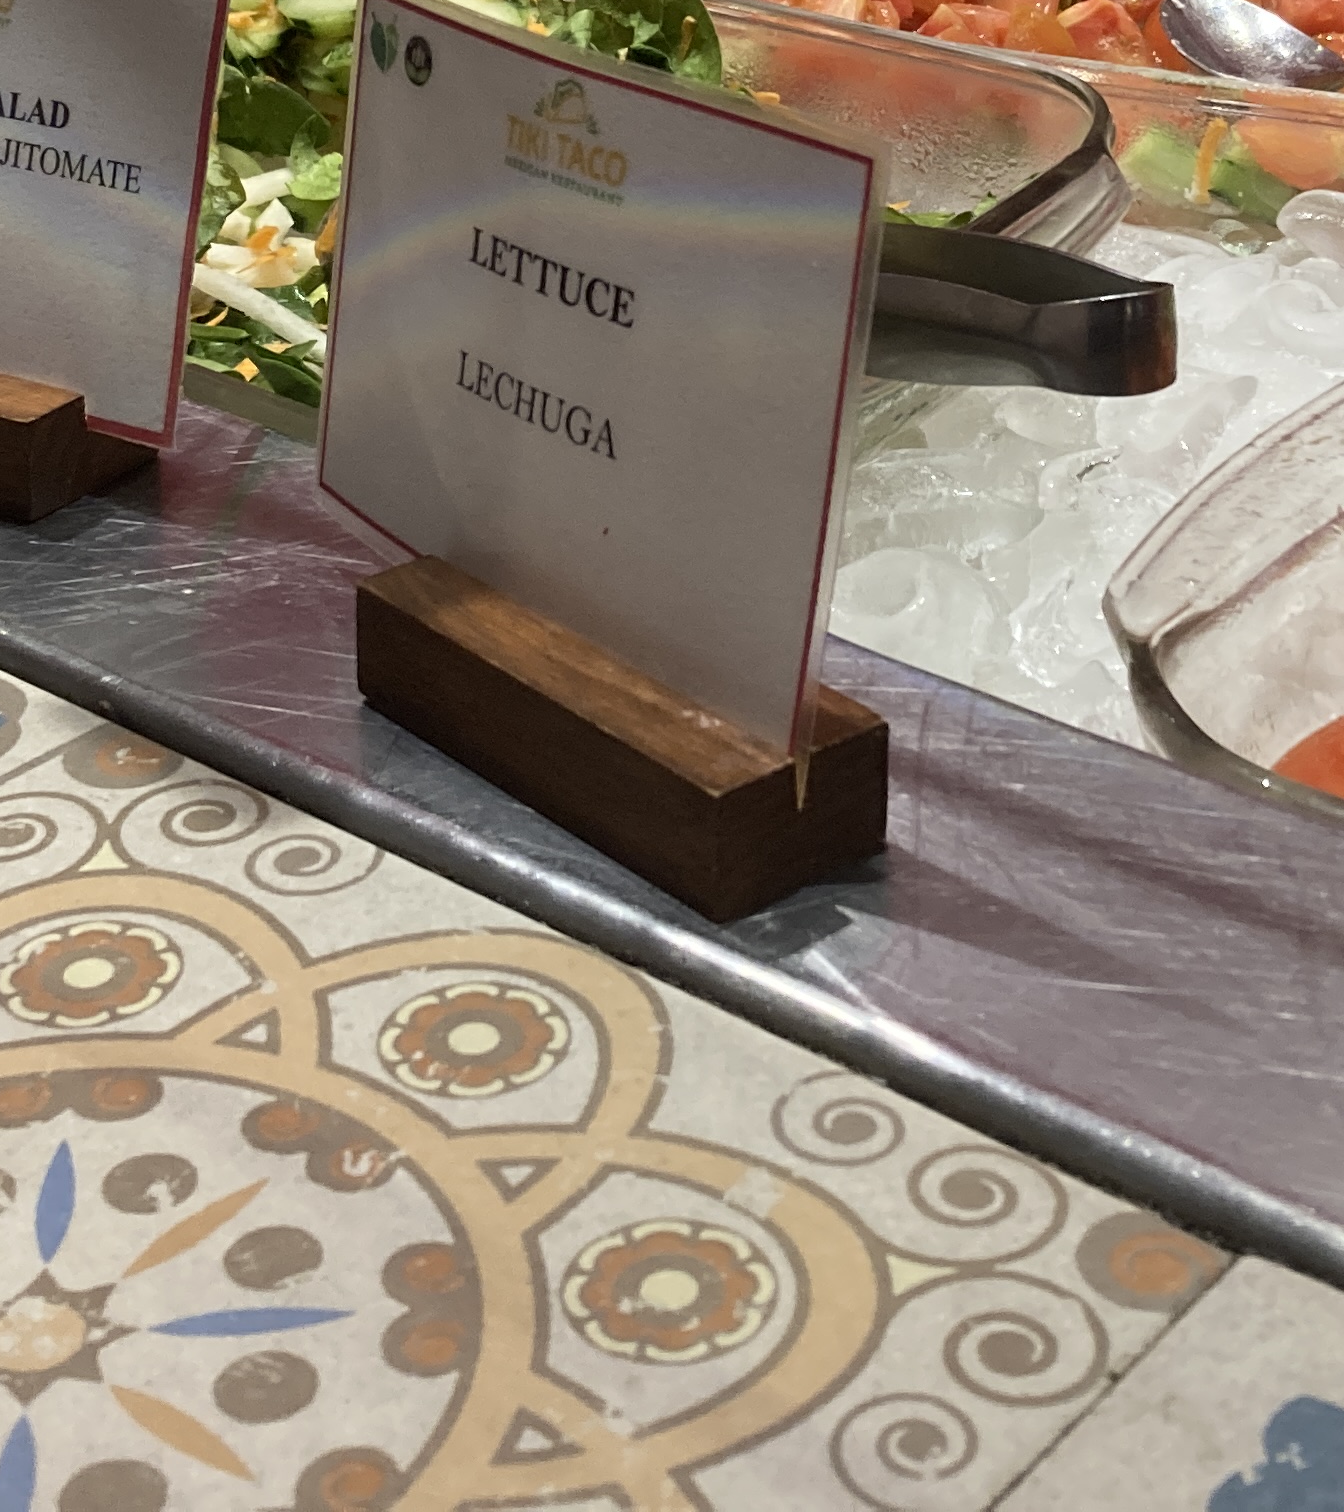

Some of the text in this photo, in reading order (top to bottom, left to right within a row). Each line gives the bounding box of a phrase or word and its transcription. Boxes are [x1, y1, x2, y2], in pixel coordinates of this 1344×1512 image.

[0, 138, 142, 194] JITOMATE
[557, 133, 628, 188] TACO
[469, 226, 635, 329] LETTUCE
[455, 350, 617, 460] LECHUGA
